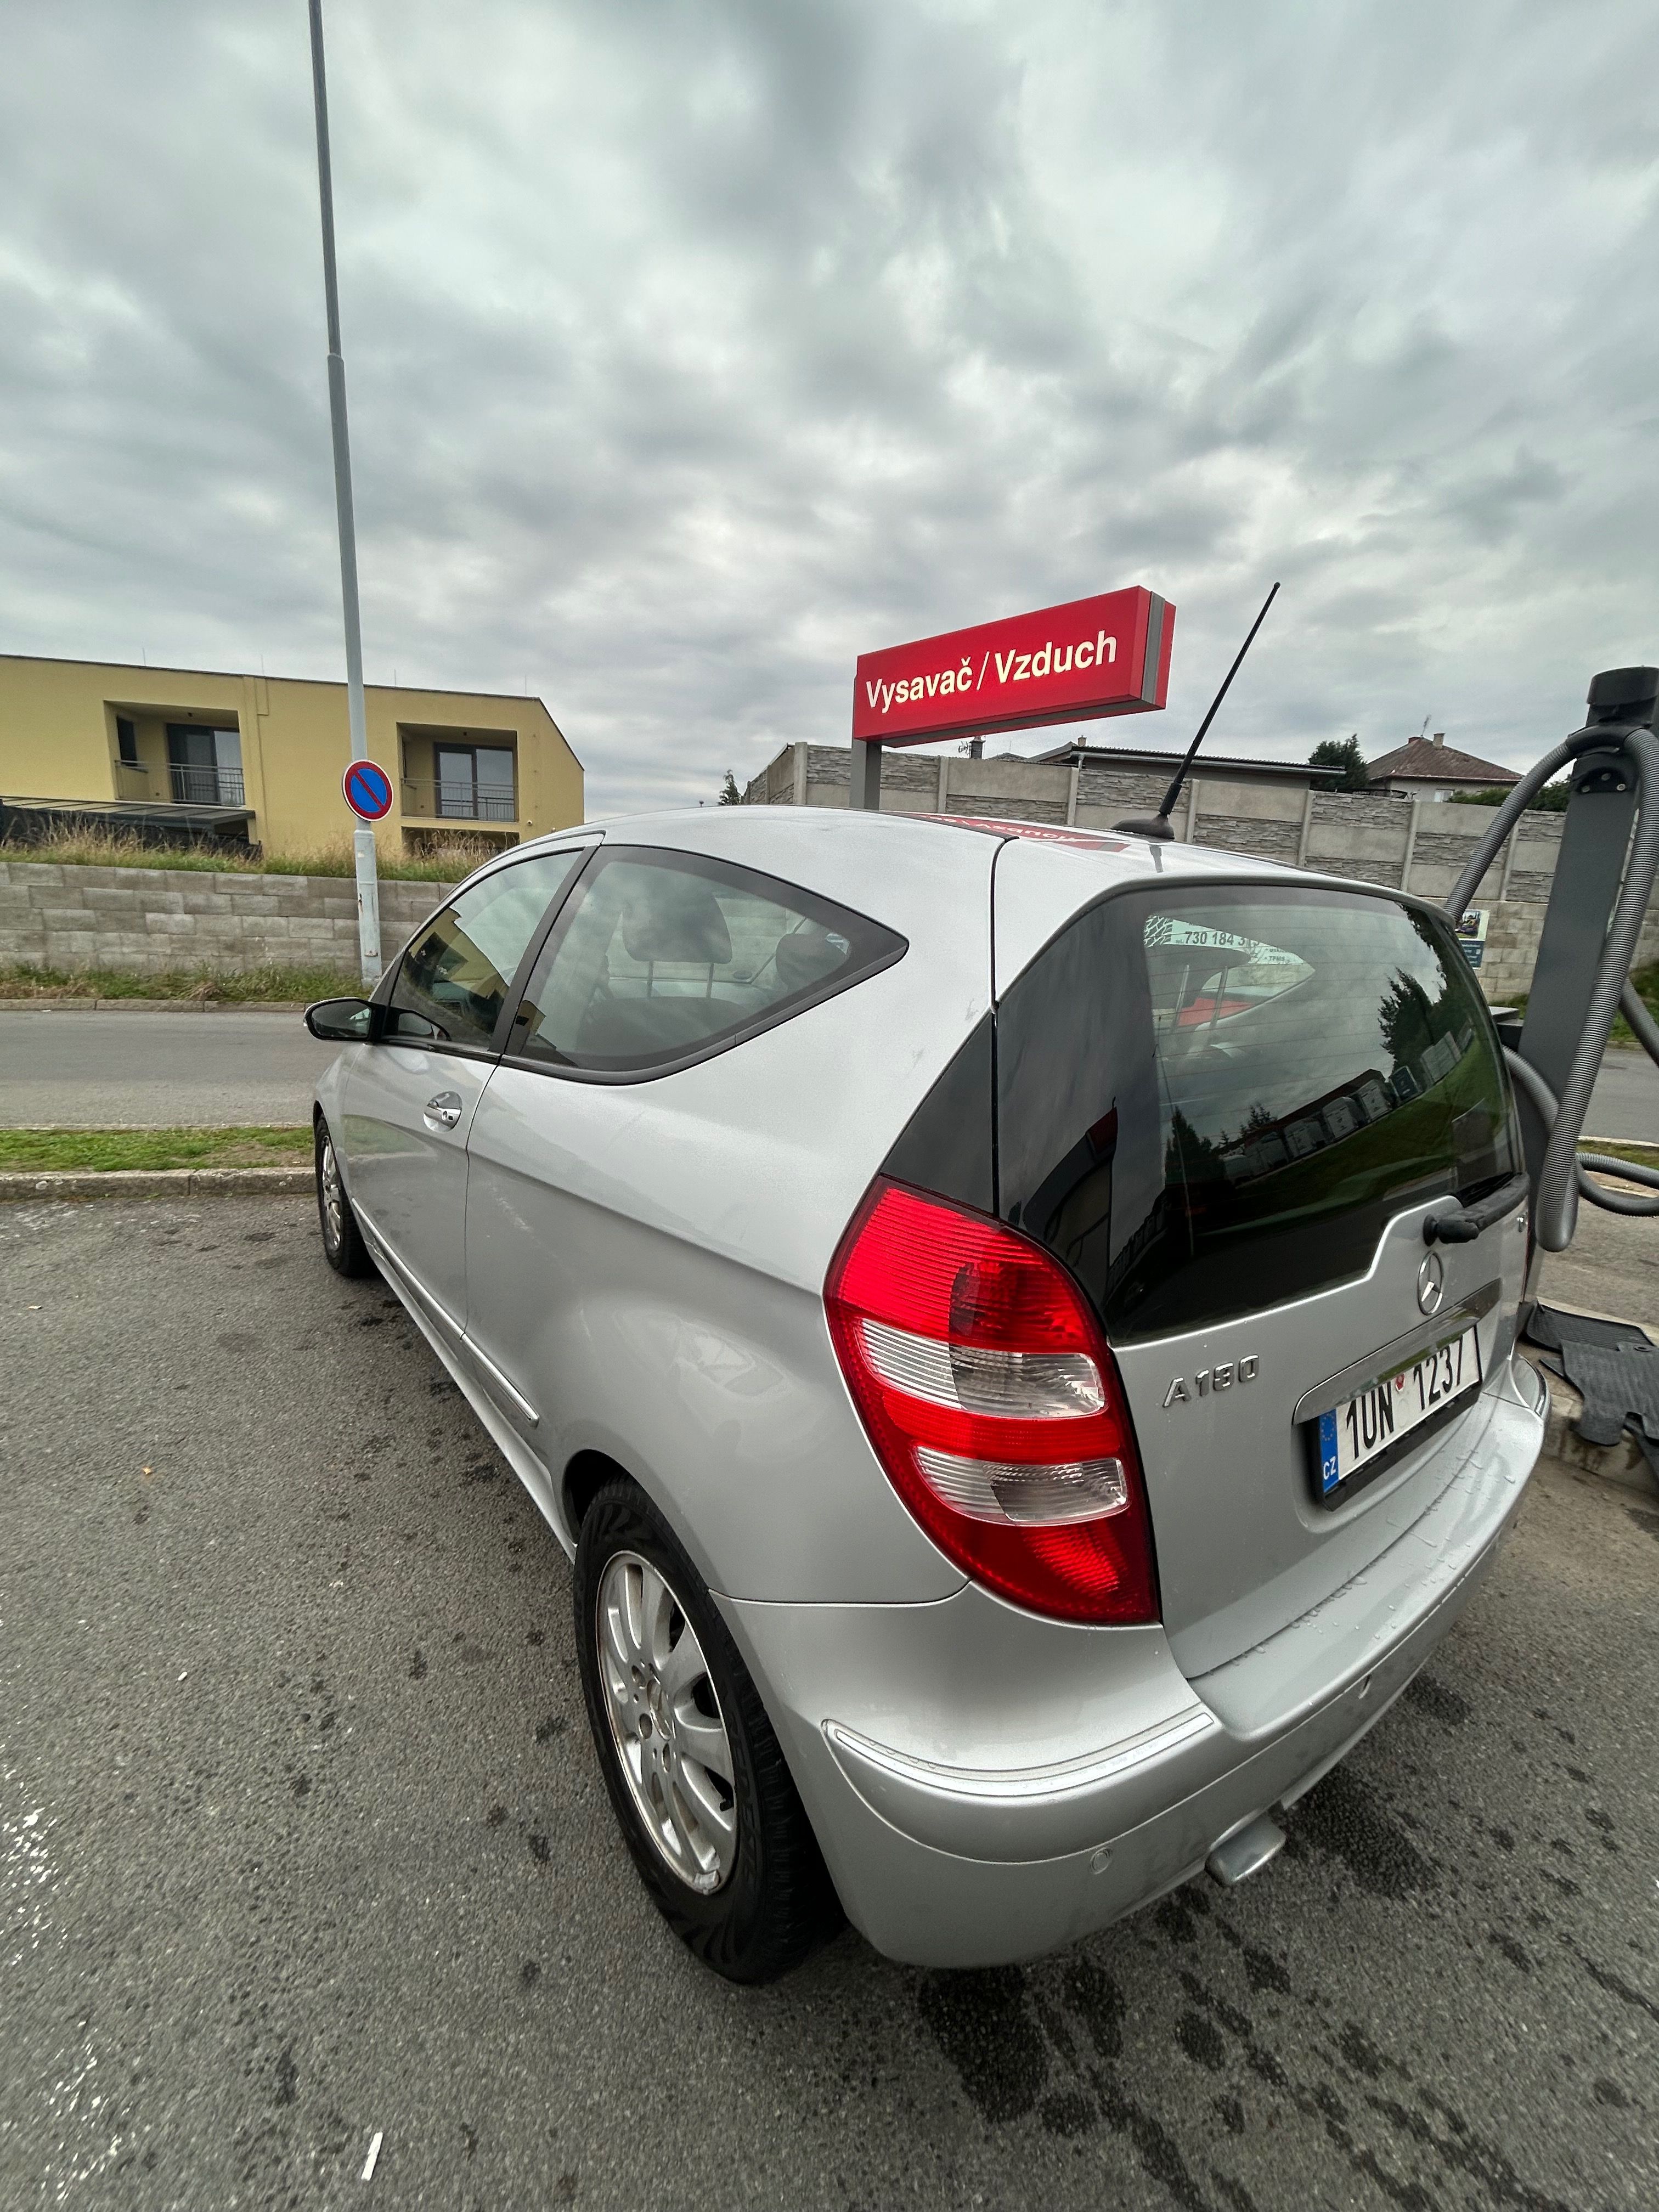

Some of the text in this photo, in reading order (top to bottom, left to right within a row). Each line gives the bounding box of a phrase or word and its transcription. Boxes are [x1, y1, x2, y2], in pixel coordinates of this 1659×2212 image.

[866, 656, 973, 714] Vysavač
[995, 629, 1117, 684] Vzduch
[1185, 931, 1207, 945] 730
[1213, 932, 1234, 945] 184
[1346, 1381, 1395, 1460] 1UN
[1323, 1455, 1336, 1480] CZ
